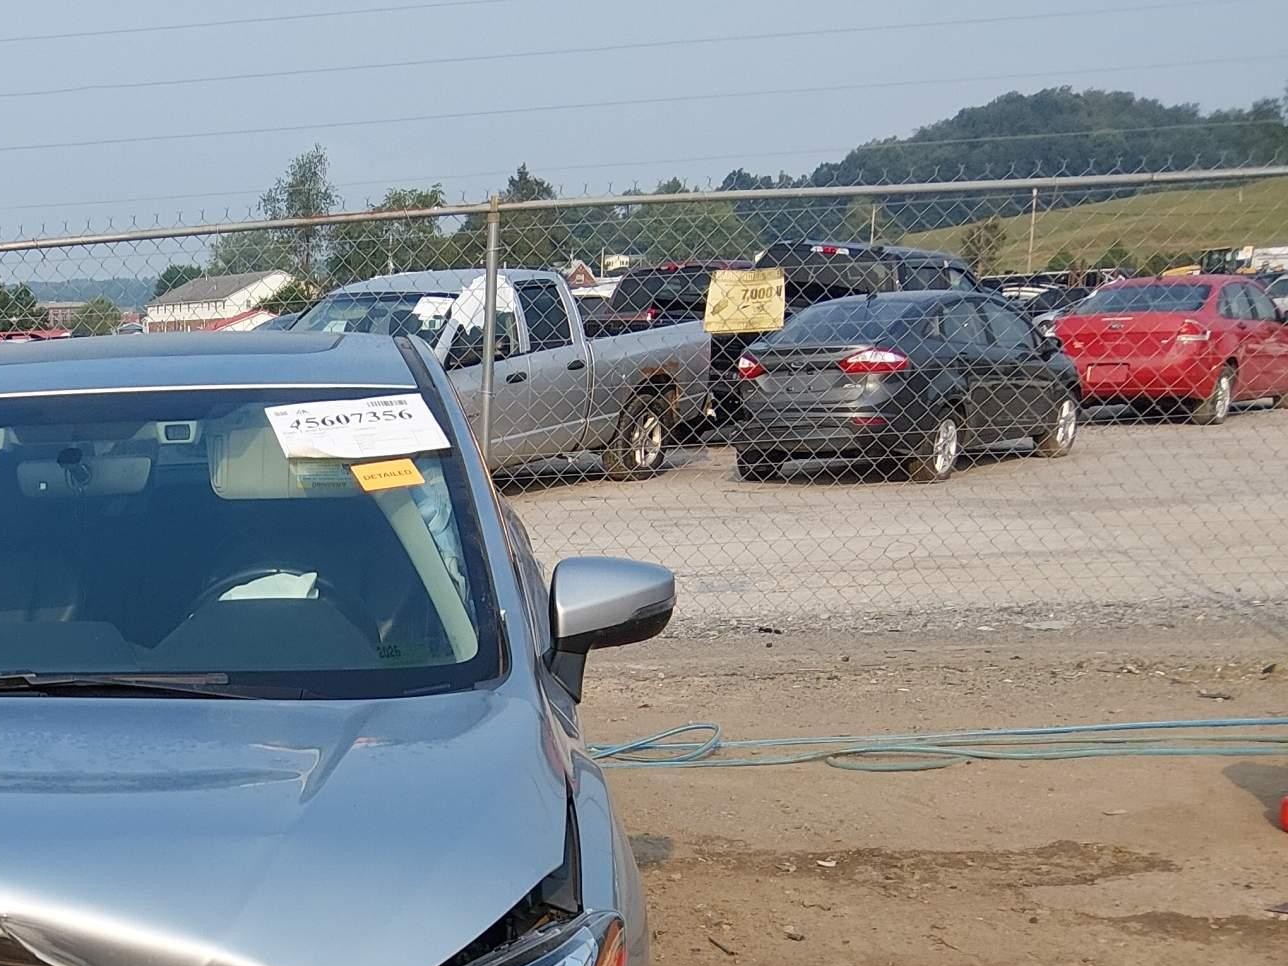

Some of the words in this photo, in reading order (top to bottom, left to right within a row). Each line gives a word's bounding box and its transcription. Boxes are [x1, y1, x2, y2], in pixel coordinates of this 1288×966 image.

[741, 286, 773, 303] 7,000
[289, 408, 413, 430] 45607356
[362, 468, 413, 481] DETAILED
